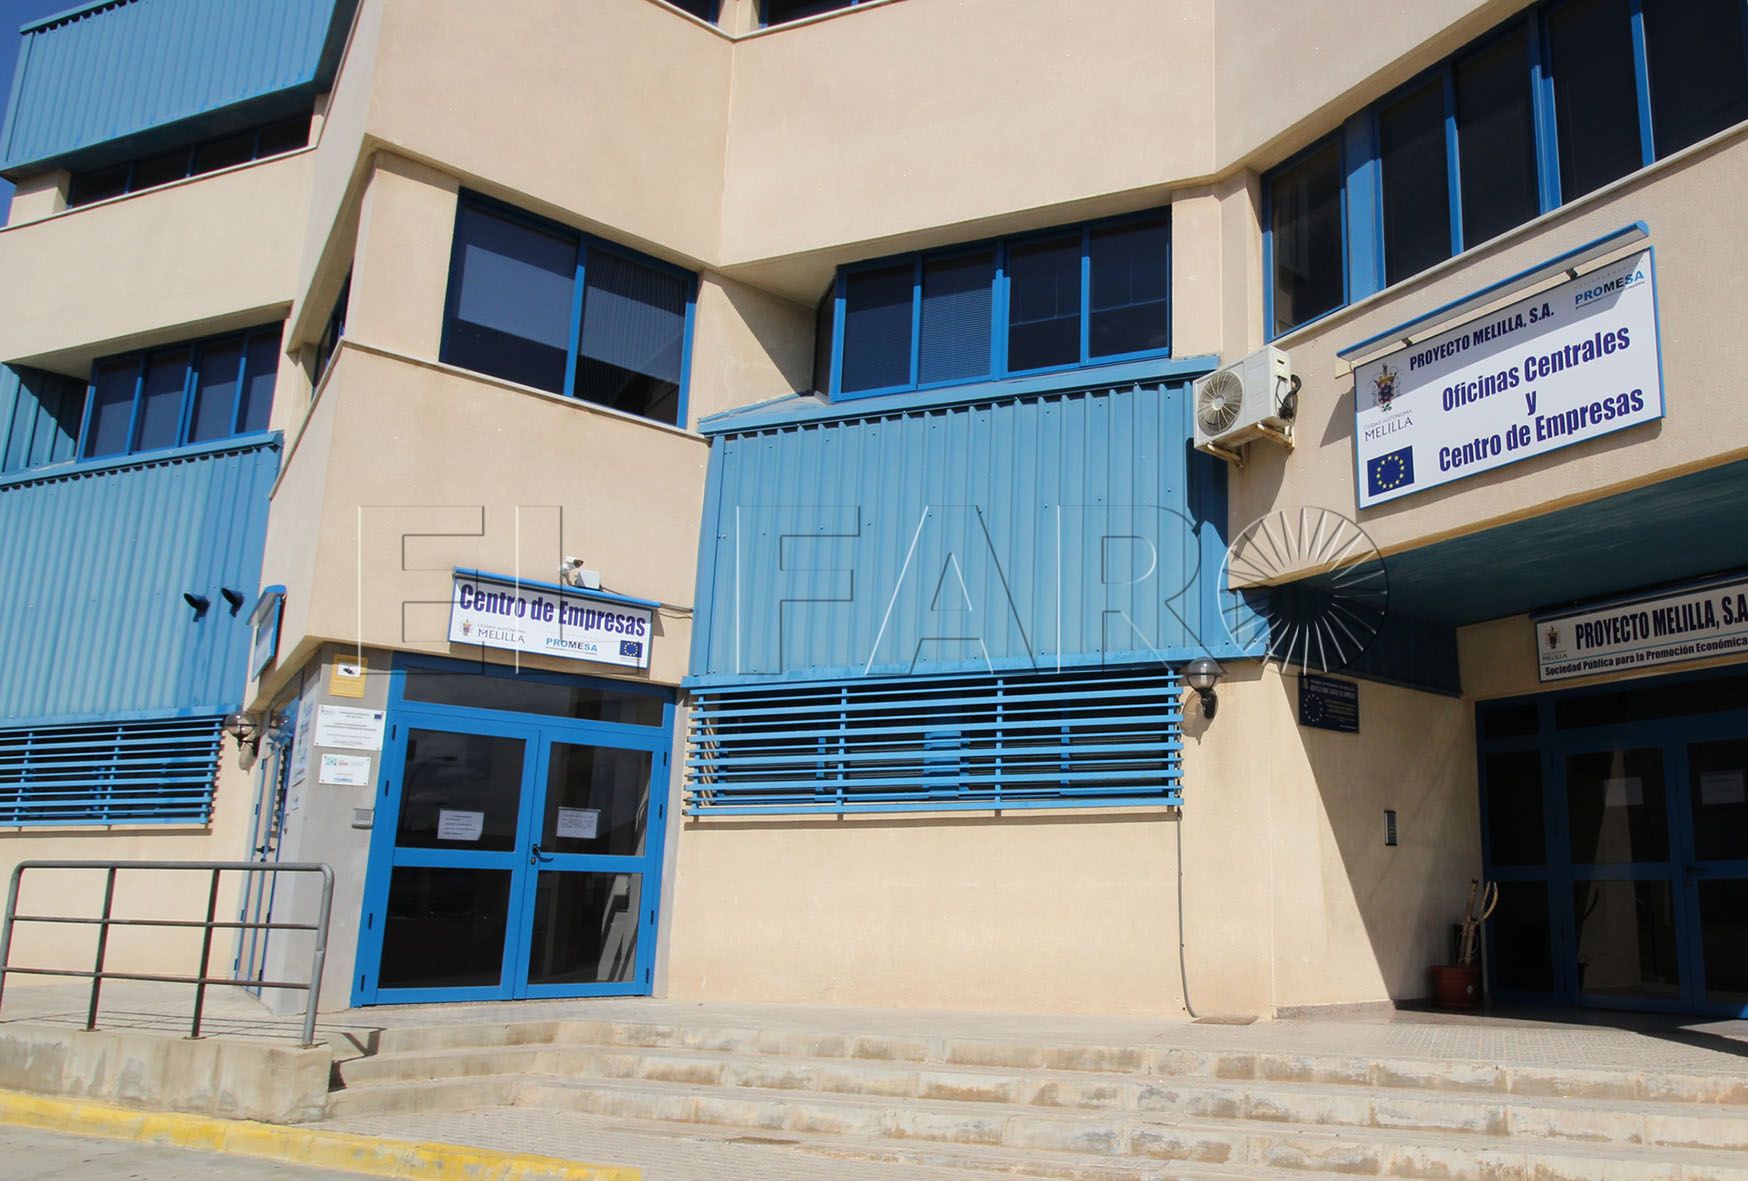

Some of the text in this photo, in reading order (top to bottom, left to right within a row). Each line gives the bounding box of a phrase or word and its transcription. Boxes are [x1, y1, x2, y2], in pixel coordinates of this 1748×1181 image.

[1575, 270, 1644, 304] PROMESA
[1410, 302, 1554, 371] PROYECTO MELILLA, S.A.
[1442, 327, 1630, 412] Oficinas Centrales
[1525, 391, 1537, 416] y
[1365, 417, 1413, 442] MELILLA
[1439, 388, 1644, 472] Centro de Empresas
[459, 583, 646, 637] Centro de Empresas
[1575, 611, 1649, 650] PROYECTO
[1652, 600, 1719, 637] MELILLA,
[478, 628, 525, 644] MELILLA
[546, 637, 598, 652] PROMESA
[1545, 637, 1748, 676] Sociedad Pública para la Promoción Económica
